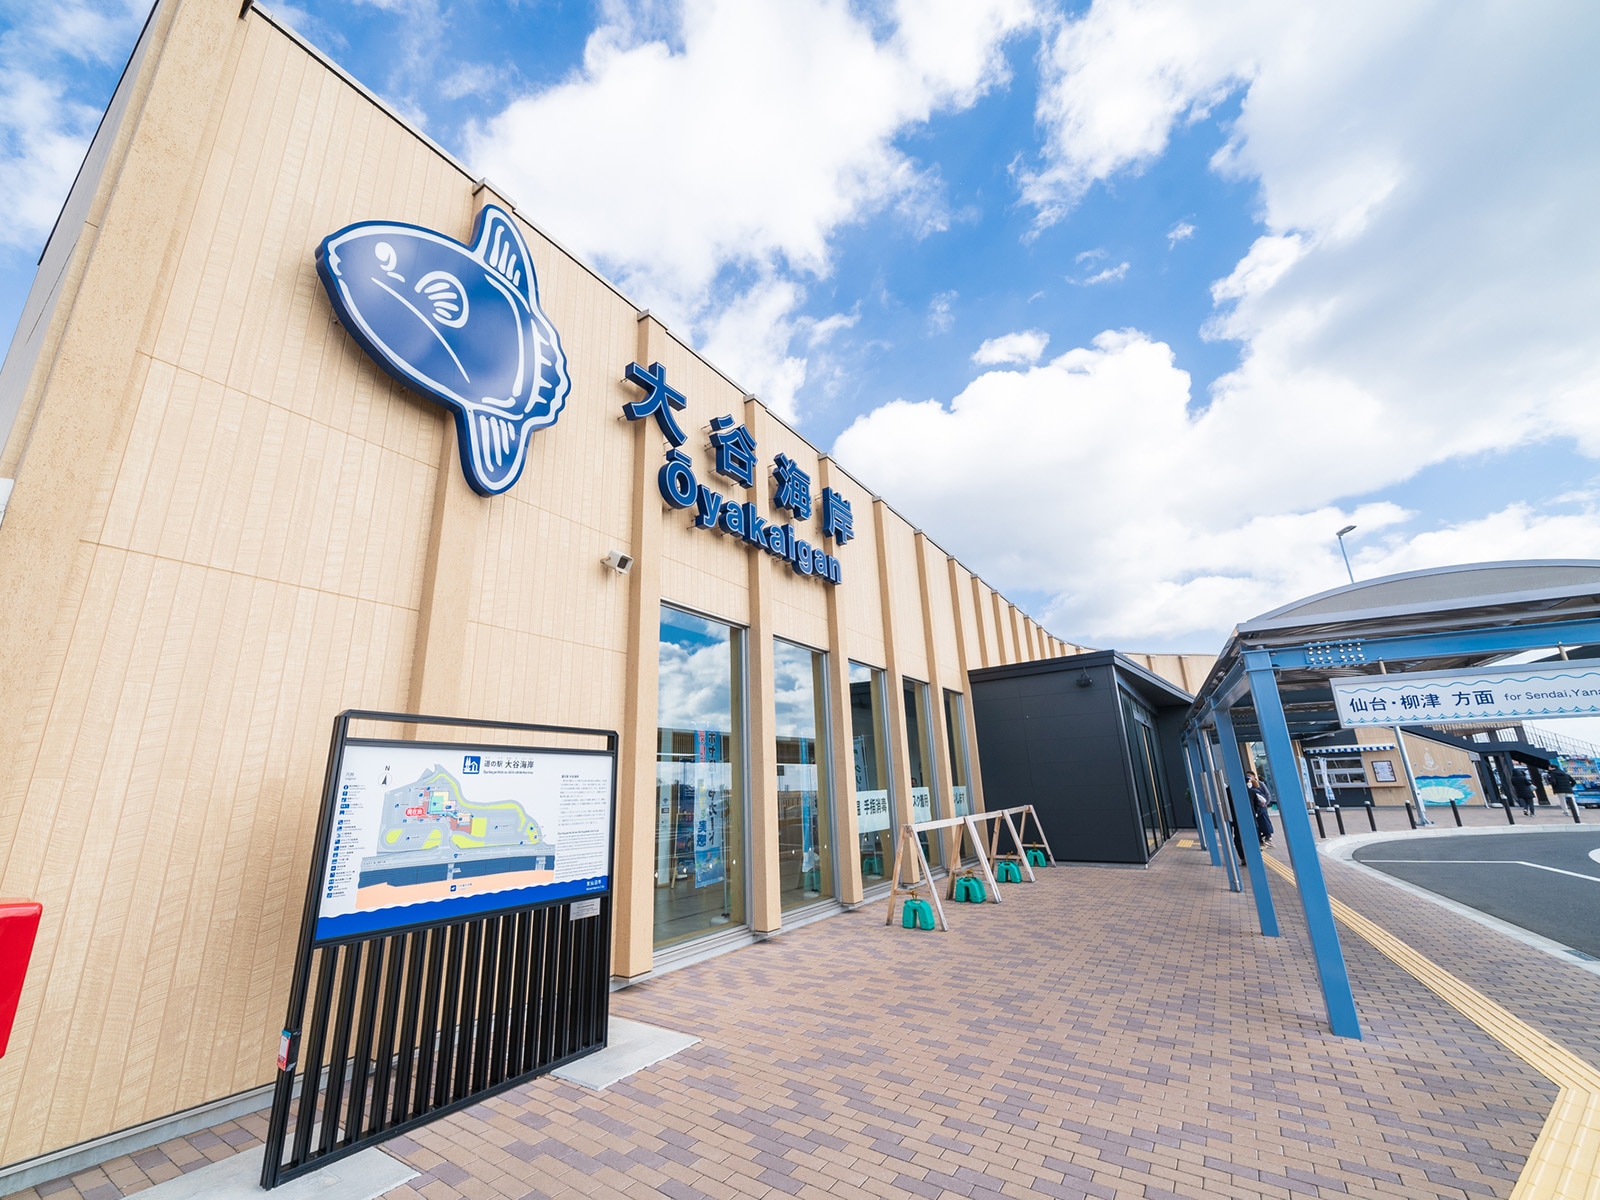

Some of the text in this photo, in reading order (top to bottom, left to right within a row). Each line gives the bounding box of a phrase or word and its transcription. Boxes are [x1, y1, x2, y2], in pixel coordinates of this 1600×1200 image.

[622, 361, 854, 546] 大谷海岸
[1349, 689, 1496, 713] 仙台・柳津 方面
[1504, 692, 1522, 701] for
[505, 760, 534, 769] 大谷海岸
